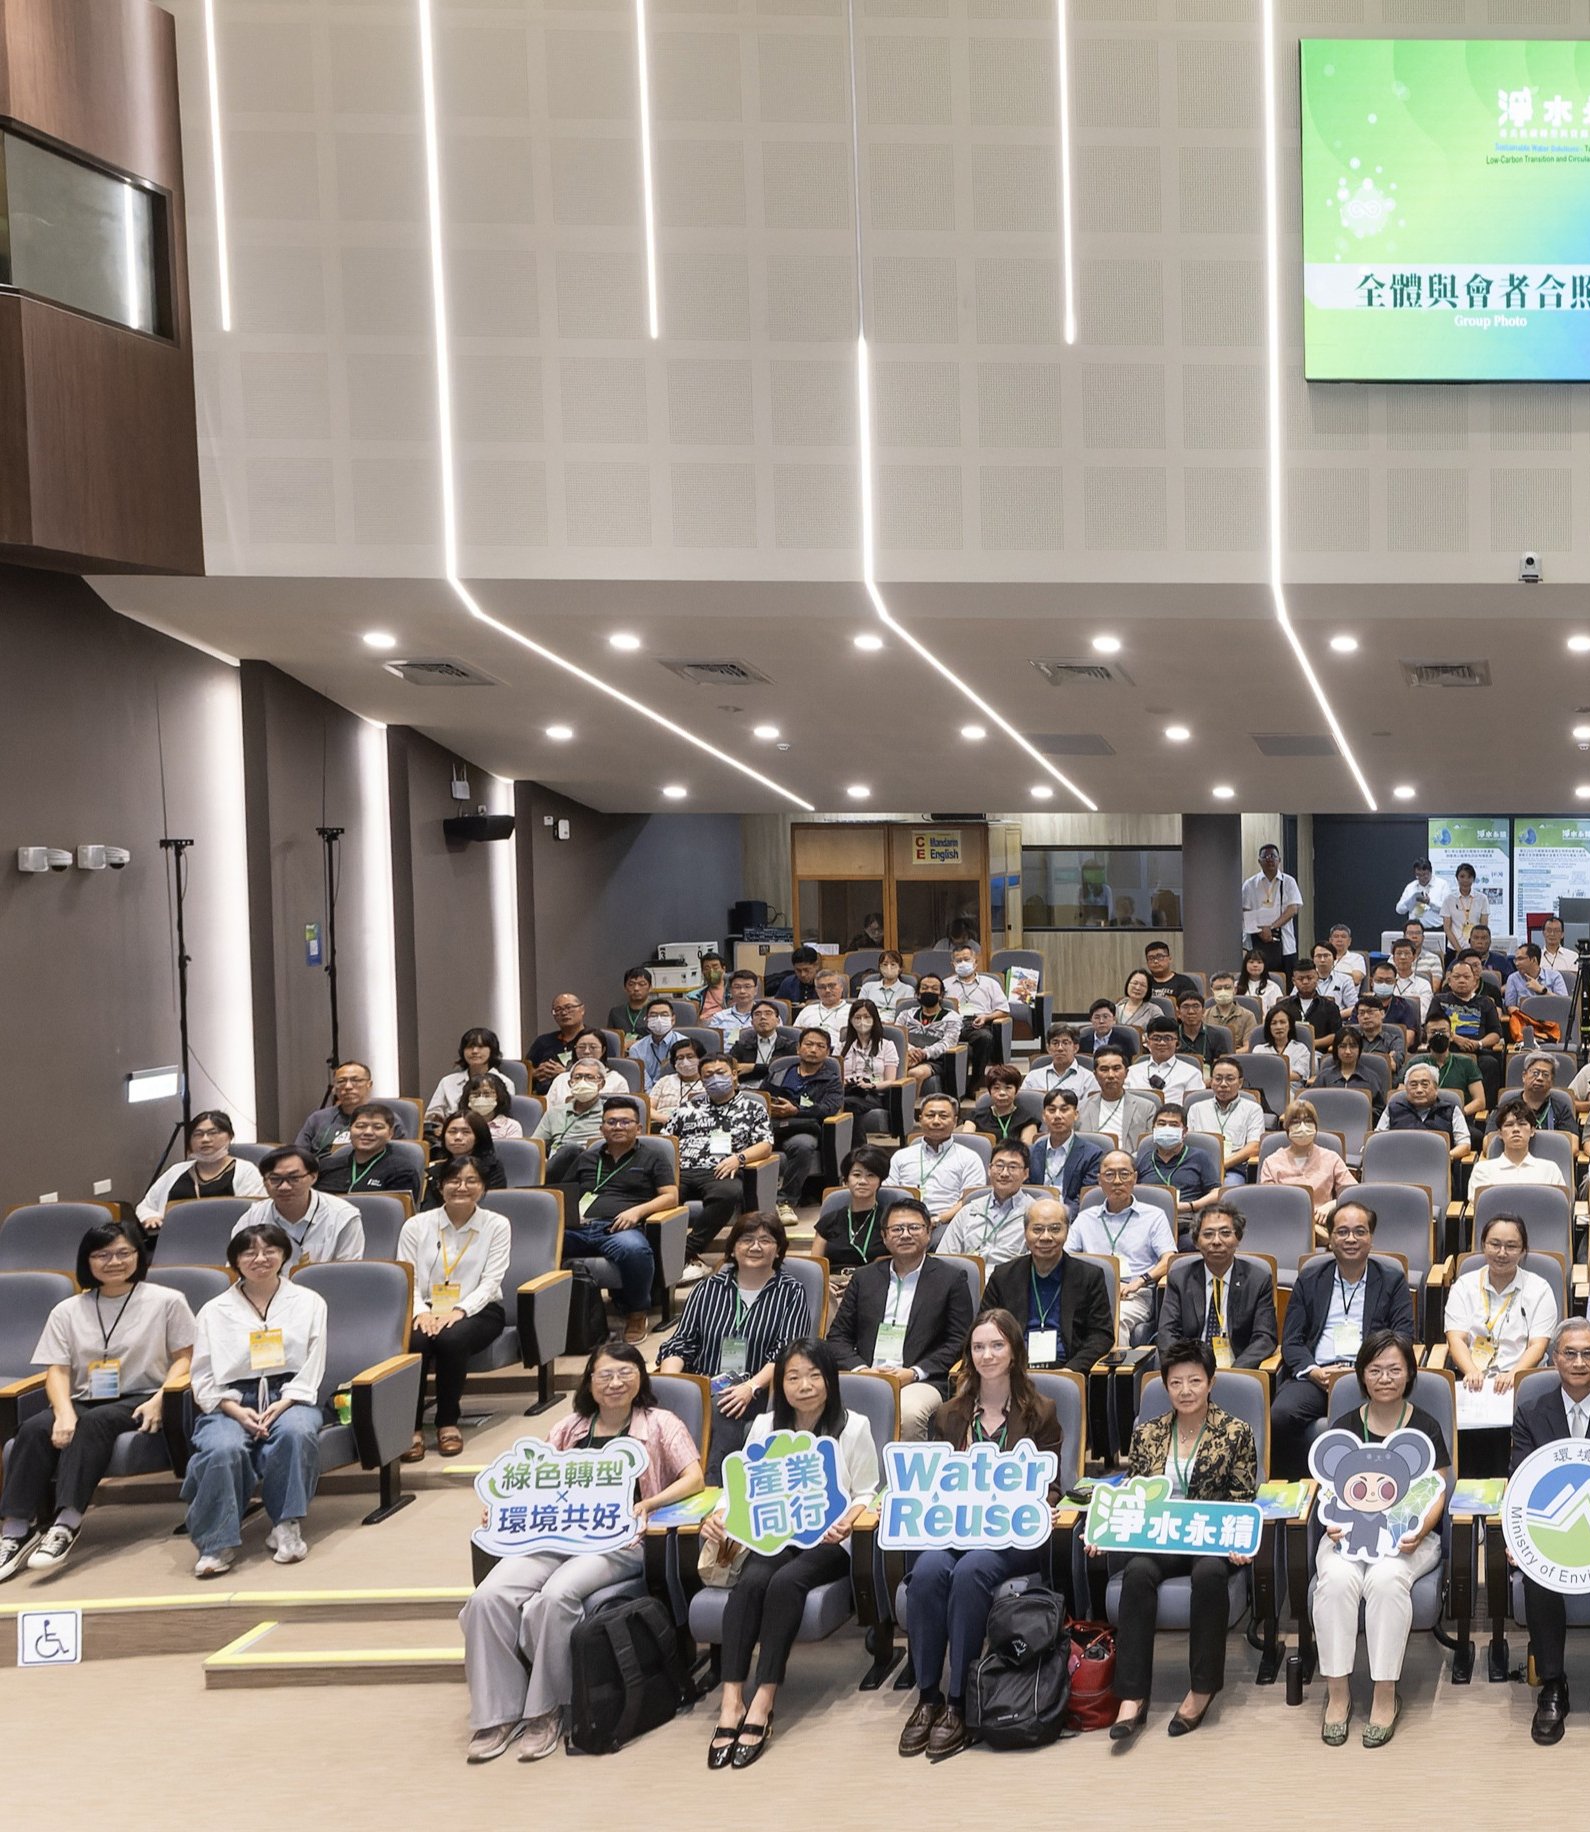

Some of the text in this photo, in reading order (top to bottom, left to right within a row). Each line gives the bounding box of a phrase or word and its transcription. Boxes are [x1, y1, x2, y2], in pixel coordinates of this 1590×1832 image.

[1486, 155, 1523, 164] Low-Carbon
[1525, 155, 1554, 163] Transition
[1454, 314, 1527, 330] Group Photo
[915, 836, 925, 847] C
[917, 849, 959, 861] E English
[501, 1460, 624, 1491] 綠色轉型
[748, 1452, 822, 1499] 產業
[893, 1452, 1046, 1493] Water
[497, 1503, 622, 1534] 環境共好
[753, 1493, 824, 1538] 同行
[888, 1498, 1041, 1538] Reuse
[1093, 1485, 1255, 1549] 淨水永續
[1511, 1506, 1538, 1565] Ministry
[1539, 1564, 1556, 1578] of
